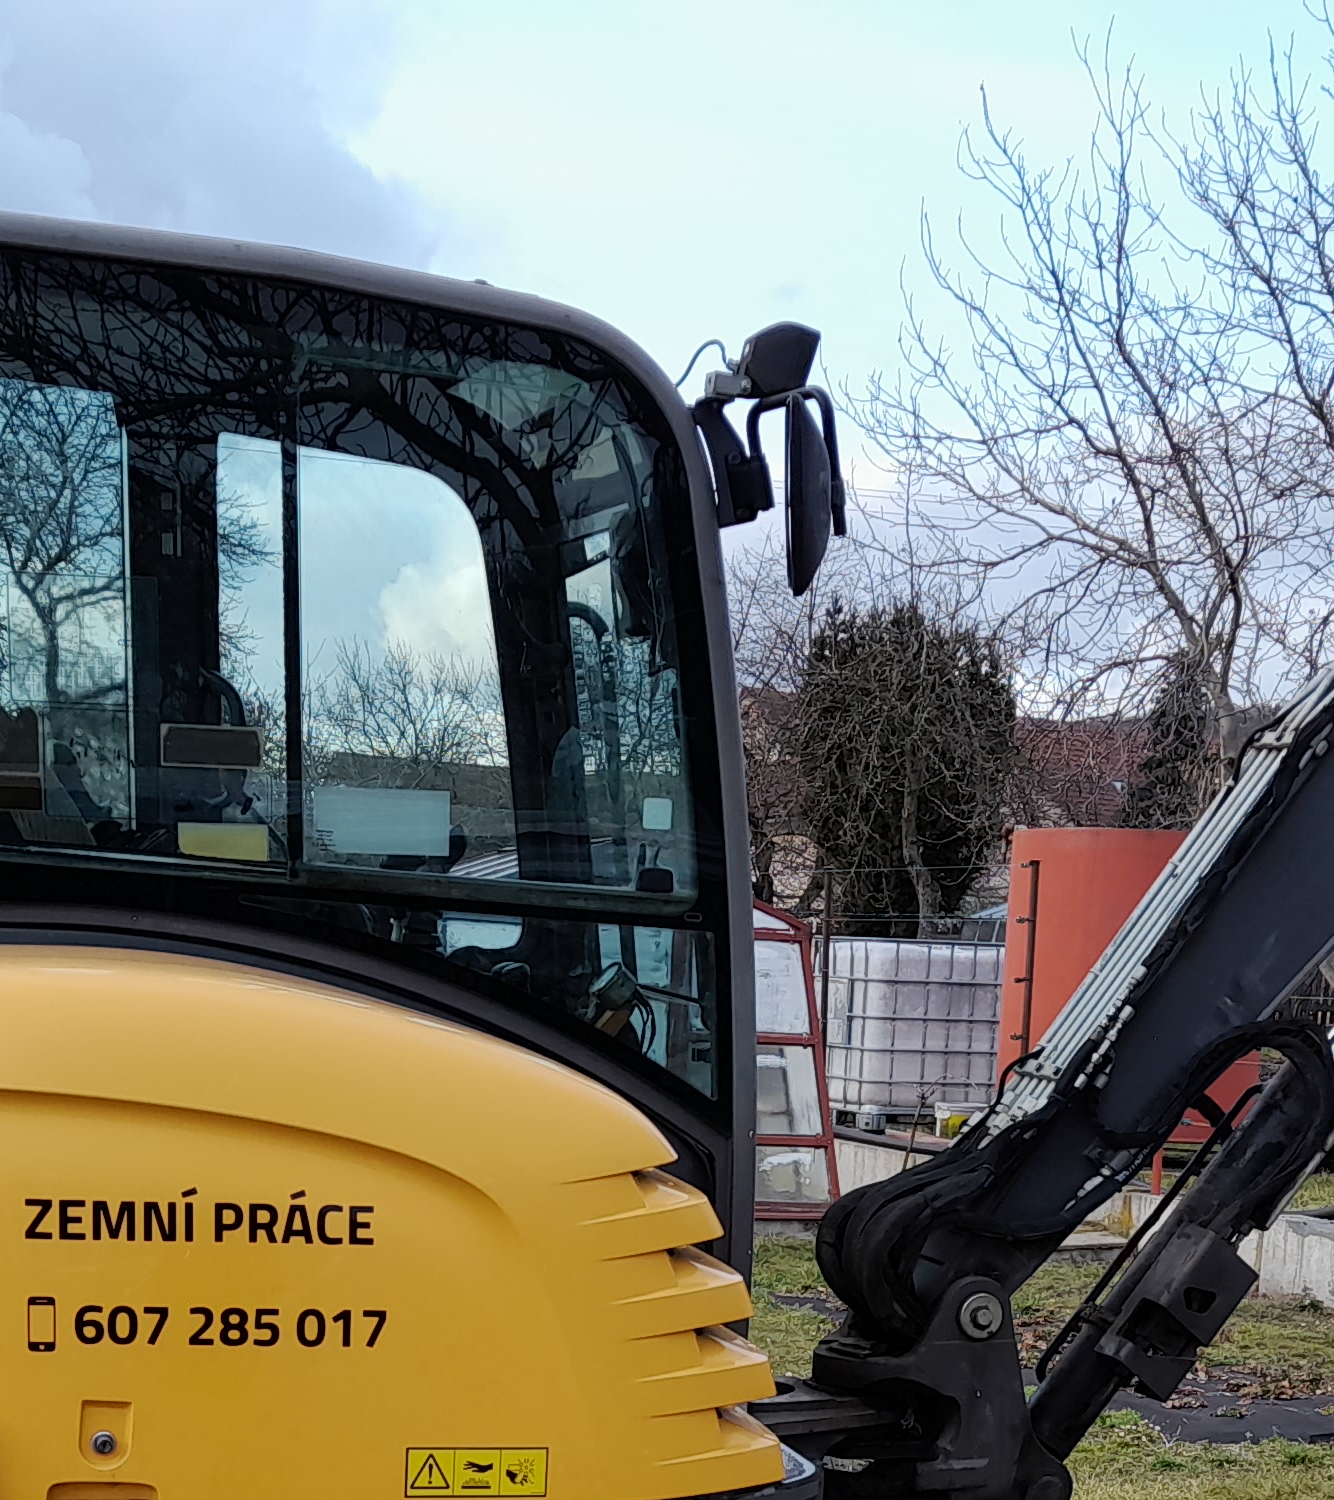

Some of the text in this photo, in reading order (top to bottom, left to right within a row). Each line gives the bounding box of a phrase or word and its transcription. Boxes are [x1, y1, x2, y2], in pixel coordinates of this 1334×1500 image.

[23, 1186, 375, 1246] ZEMNÍ PRÁCE
[74, 1304, 387, 1348] 607 285 017
